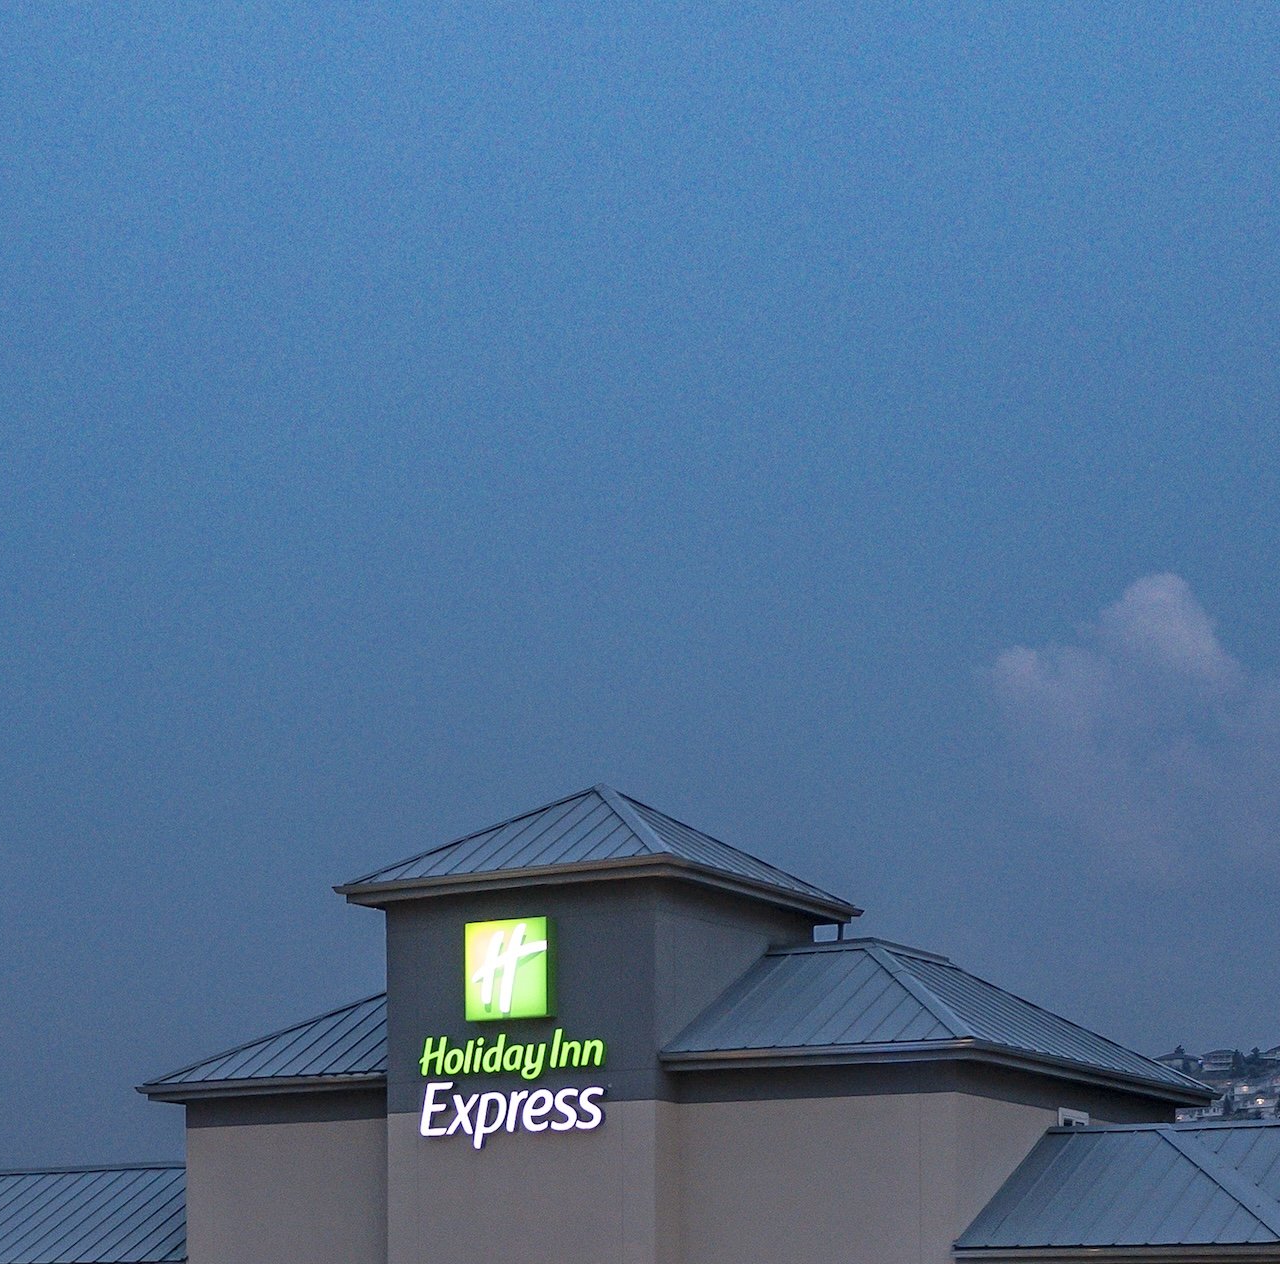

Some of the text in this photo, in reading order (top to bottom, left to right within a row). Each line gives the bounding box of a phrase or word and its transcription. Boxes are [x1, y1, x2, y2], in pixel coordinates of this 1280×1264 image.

[419, 1028, 604, 1080] Holiday Inn
[420, 1081, 605, 1150] Express
